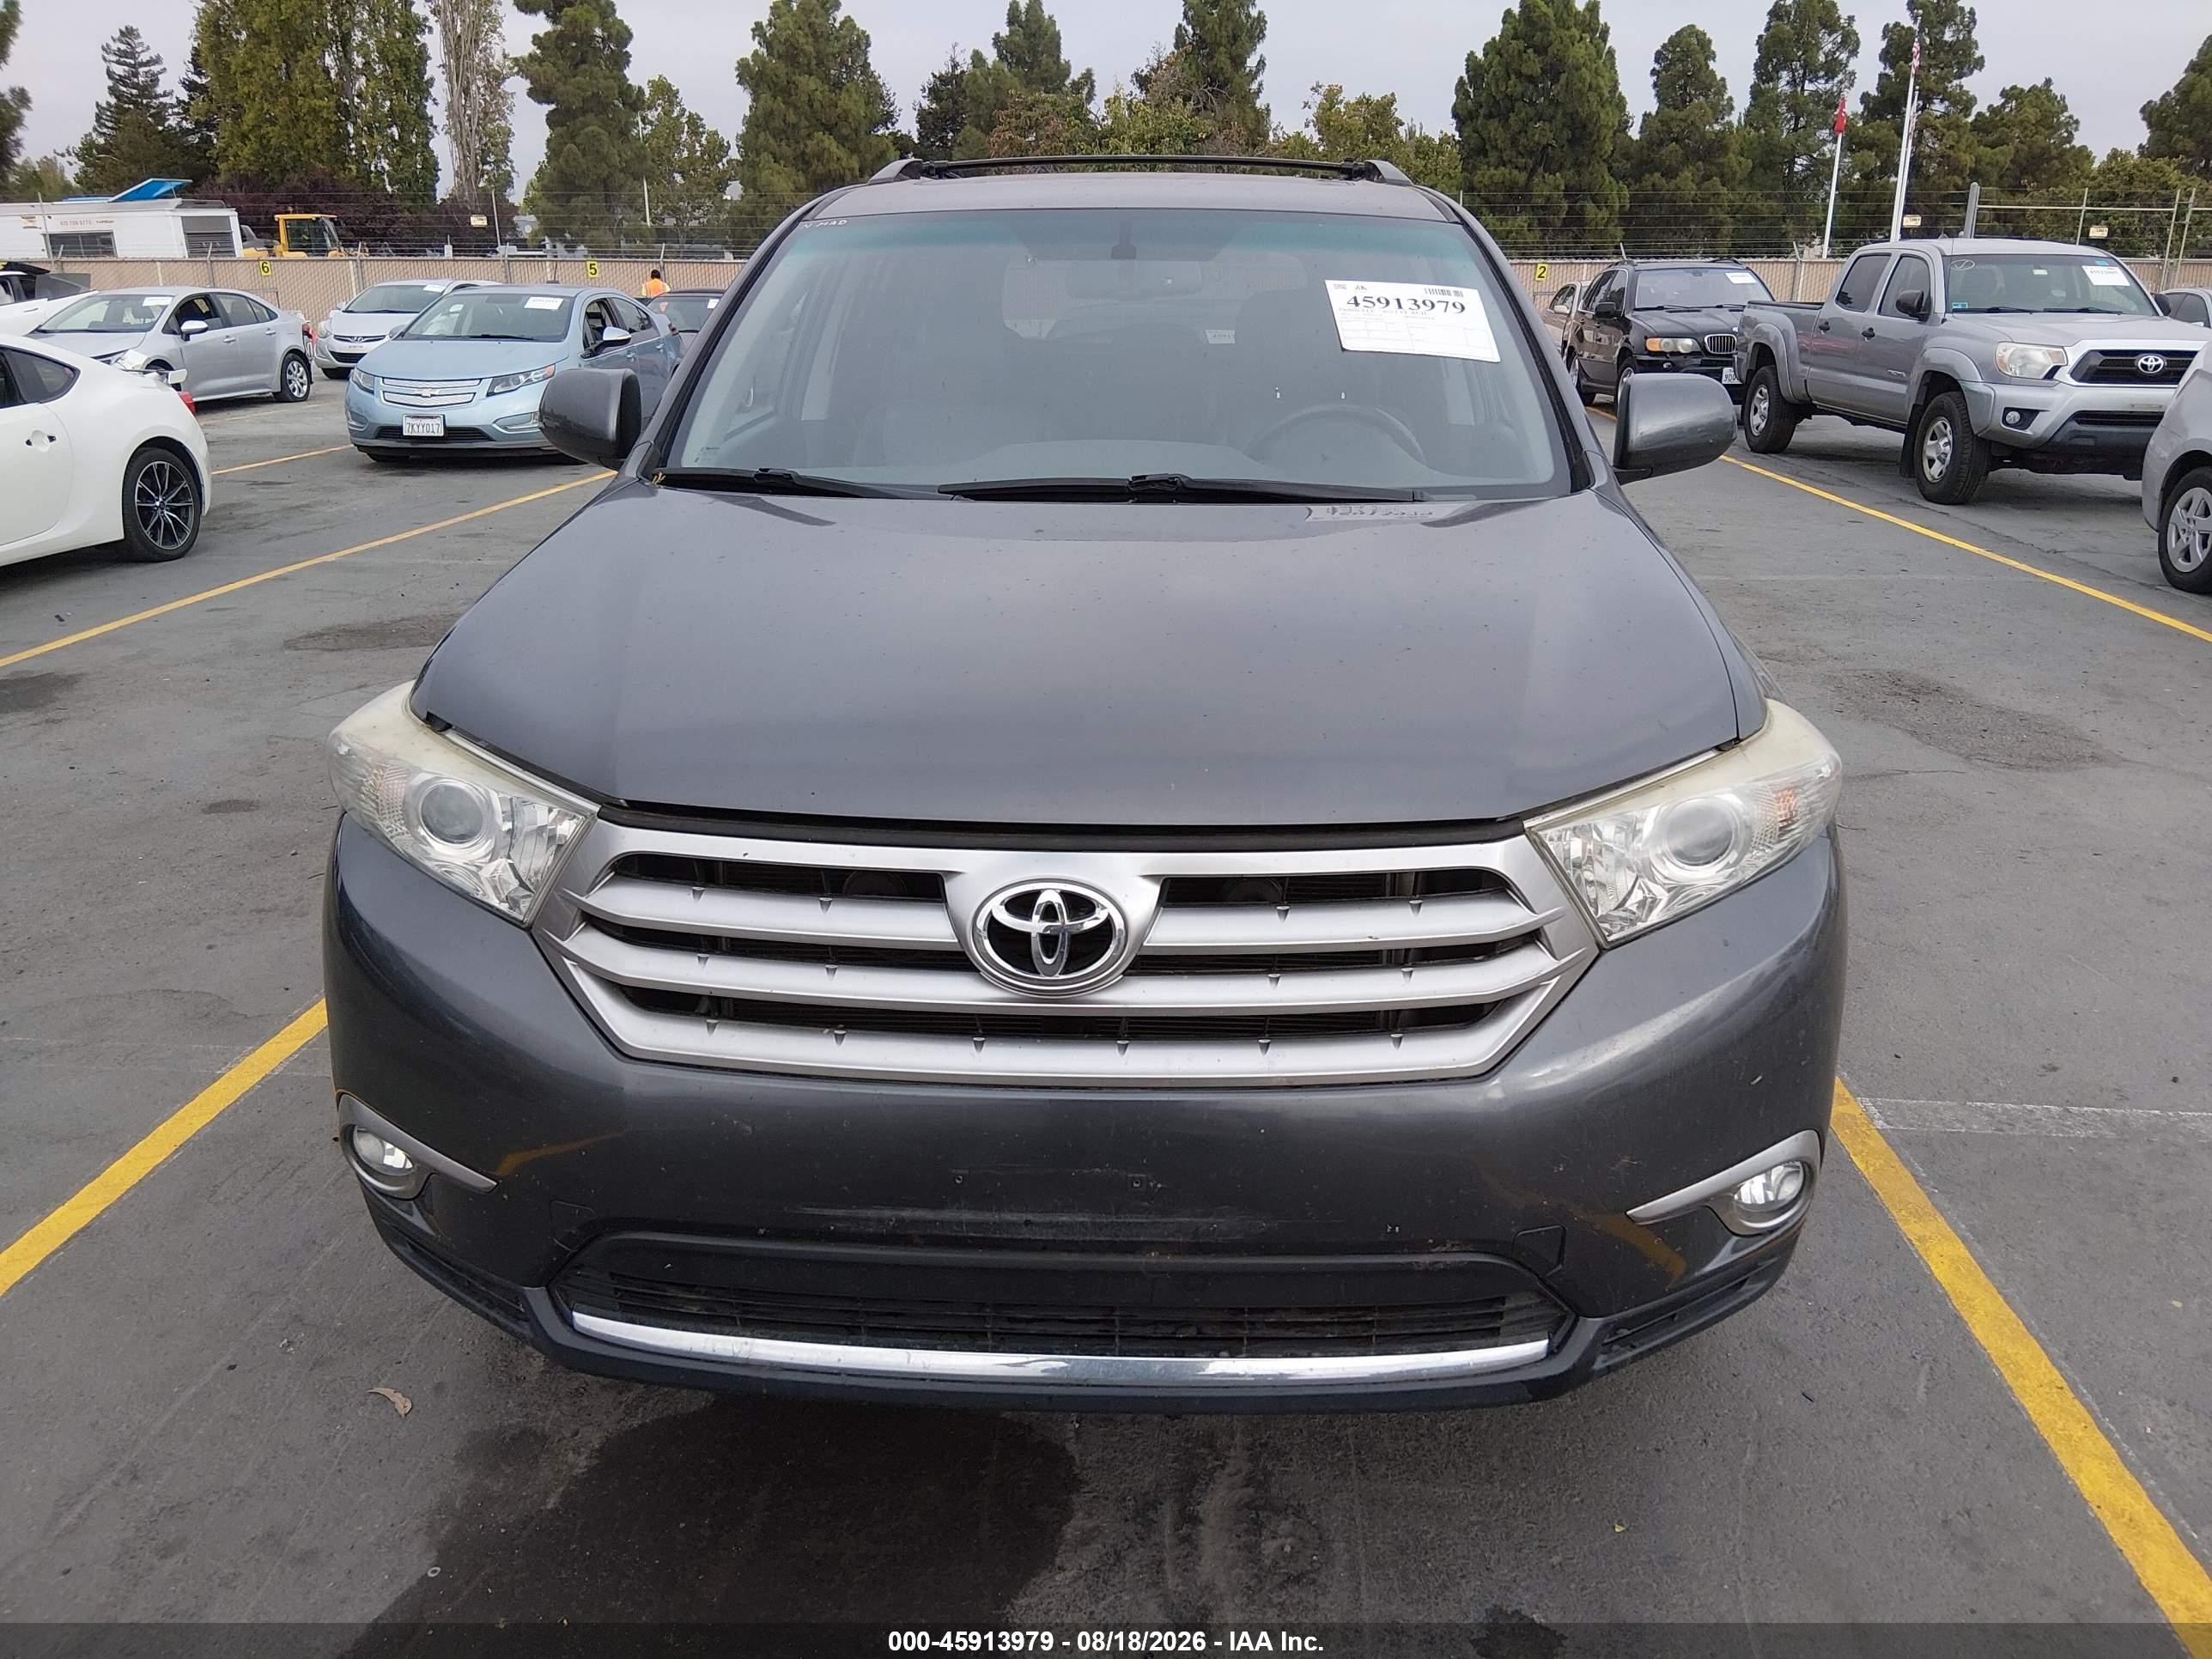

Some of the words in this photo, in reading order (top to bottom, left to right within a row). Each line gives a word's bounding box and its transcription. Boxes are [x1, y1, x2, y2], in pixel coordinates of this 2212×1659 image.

[262, 262, 270, 274] 6
[590, 263, 598, 276] 5
[1537, 266, 1547, 279] 2
[1346, 295, 1465, 314] 45913979
